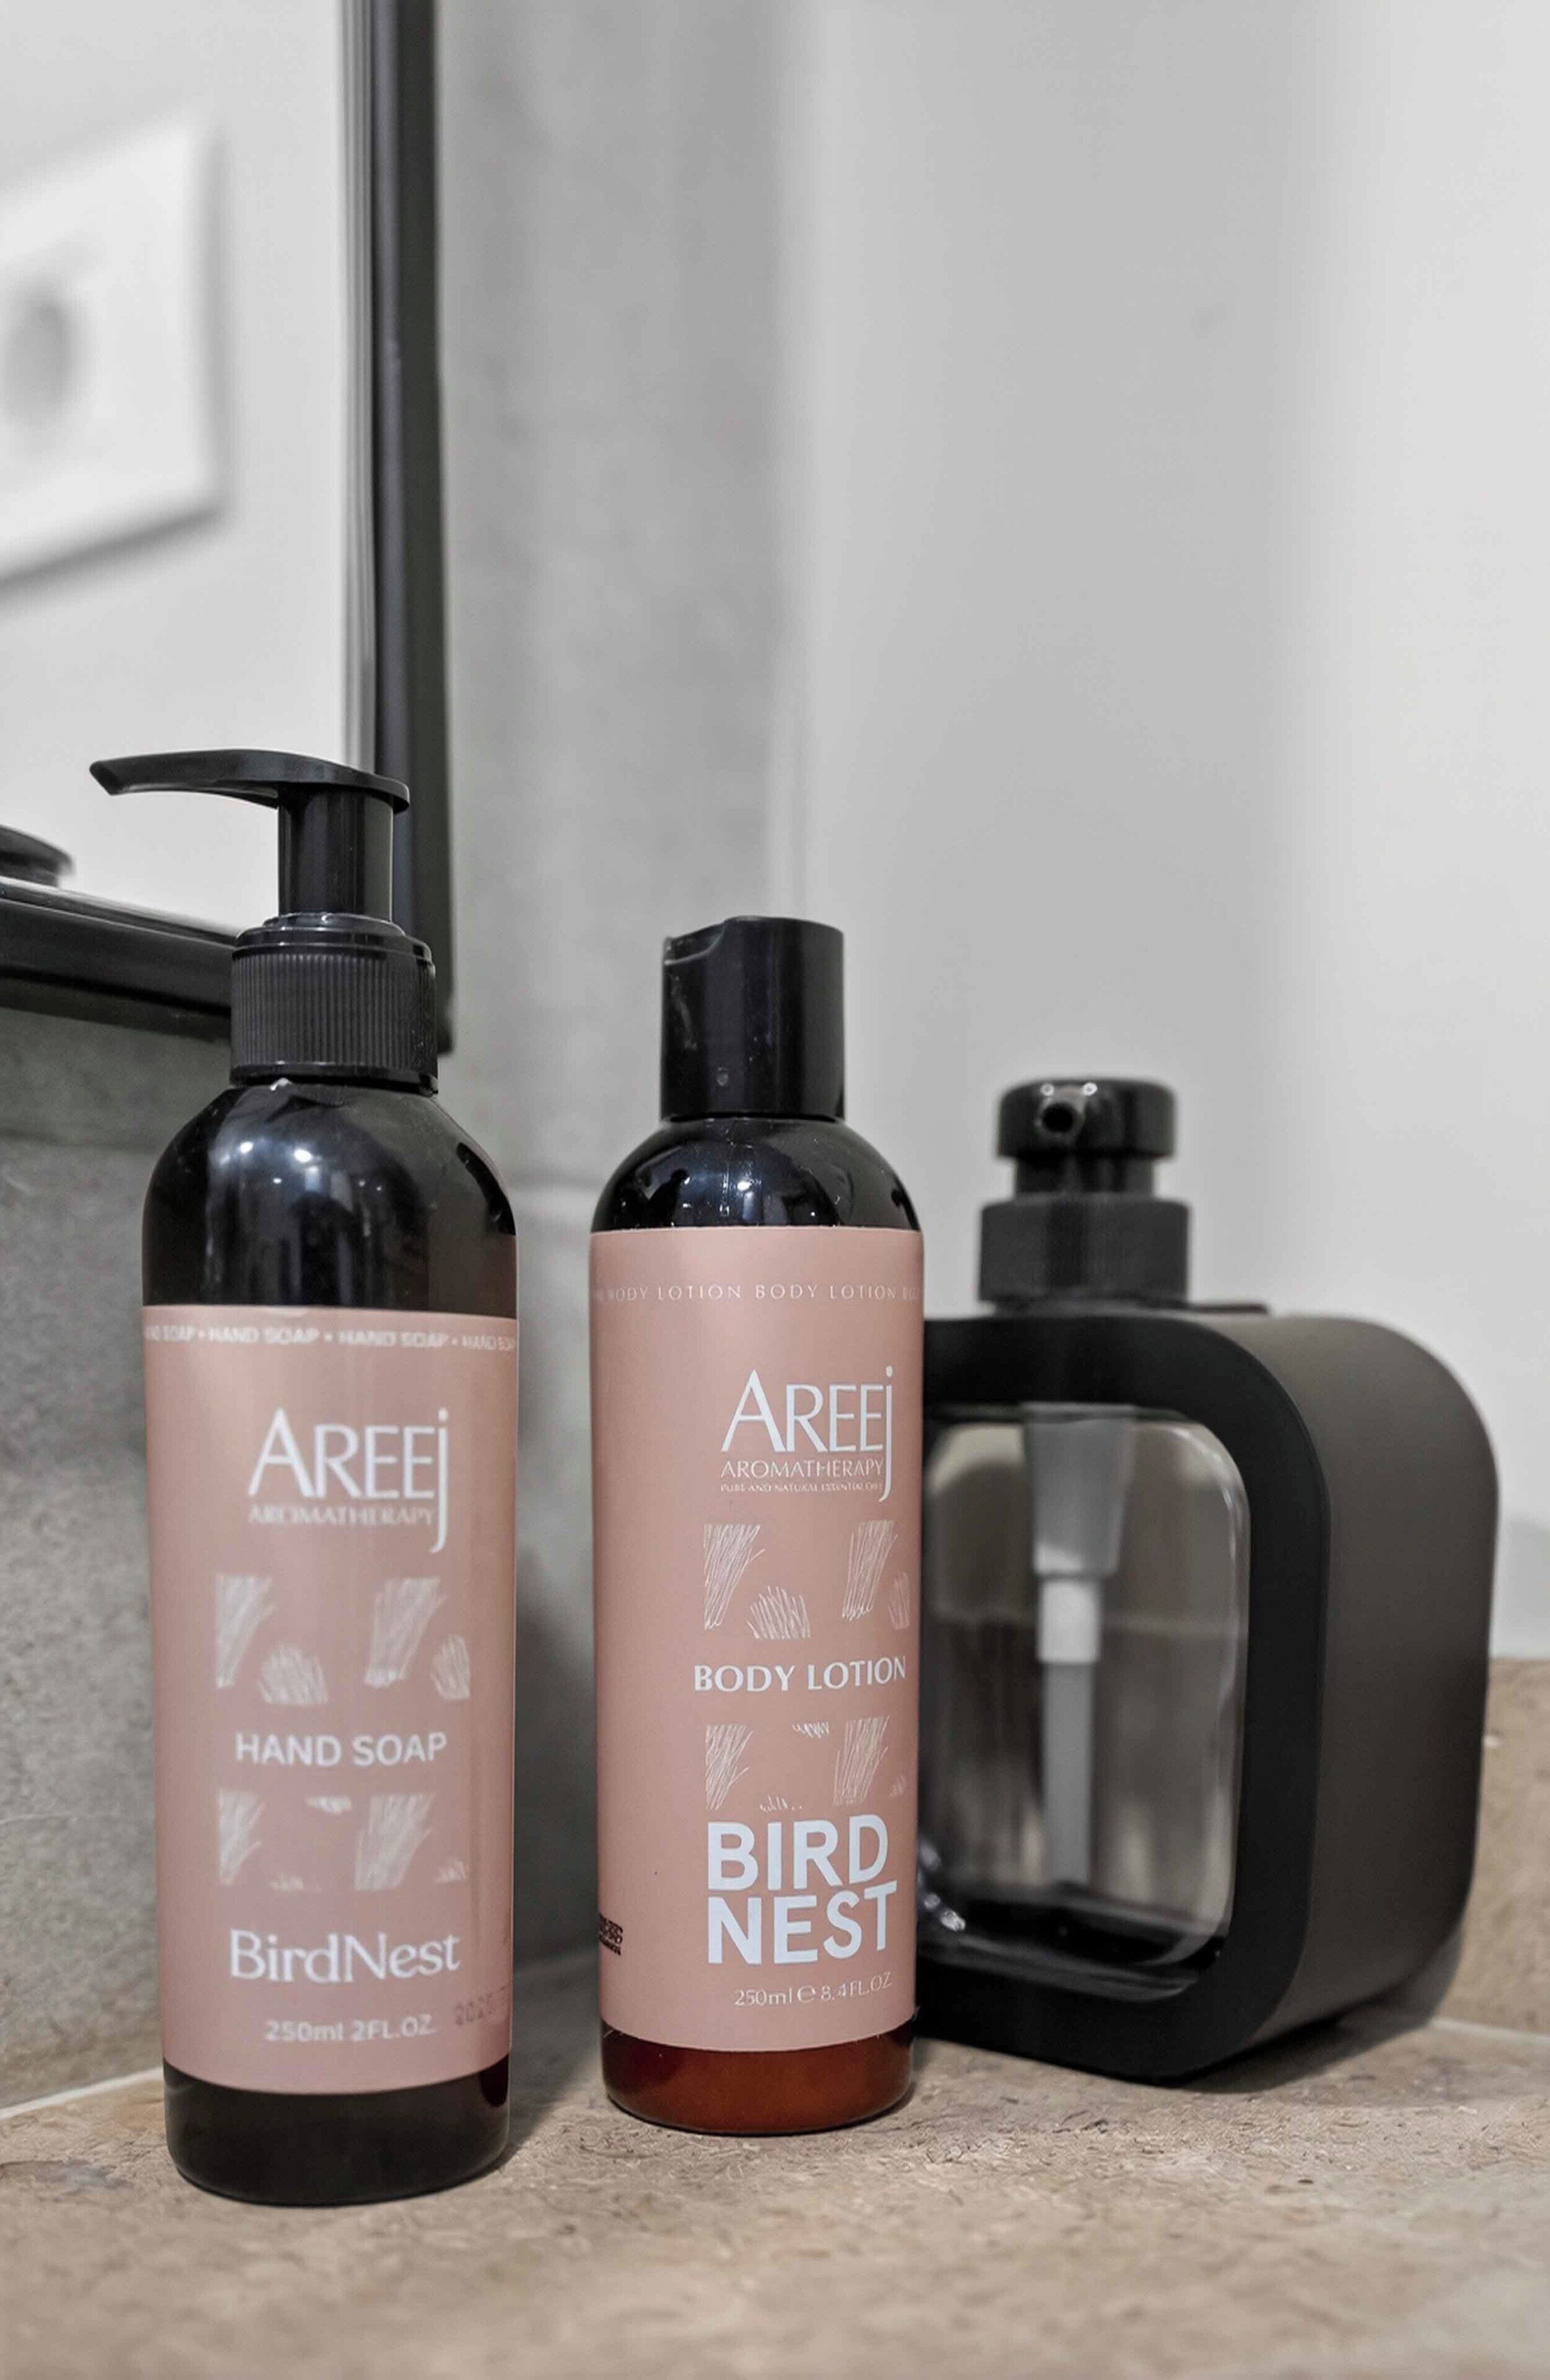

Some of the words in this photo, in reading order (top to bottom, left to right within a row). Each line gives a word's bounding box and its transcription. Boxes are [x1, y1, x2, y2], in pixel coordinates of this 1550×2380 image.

[658, 1285, 742, 1301] LOTION
[755, 1284, 817, 1300] BODY
[829, 1283, 897, 1301] LOTION
[208, 1326, 260, 1344] HAND
[263, 1327, 320, 1345] SOAP
[338, 1330, 397, 1347] HAND
[400, 1332, 449, 1348] SOAP
[720, 1458, 884, 1479] AROMATHERAPY
[249, 1503, 434, 1526] AROMATHERAPY
[694, 1664, 796, 1693] BODY
[808, 1656, 906, 1691] LOTION
[235, 1732, 341, 1767] HAND
[352, 1732, 447, 1766] SOAP
[707, 1814, 888, 1891] BIRD
[707, 1880, 897, 1964] NEST
[229, 1928, 460, 1984] BirdNest
[734, 1987, 793, 2007] 250ml
[264, 2019, 343, 2042] 250ml
